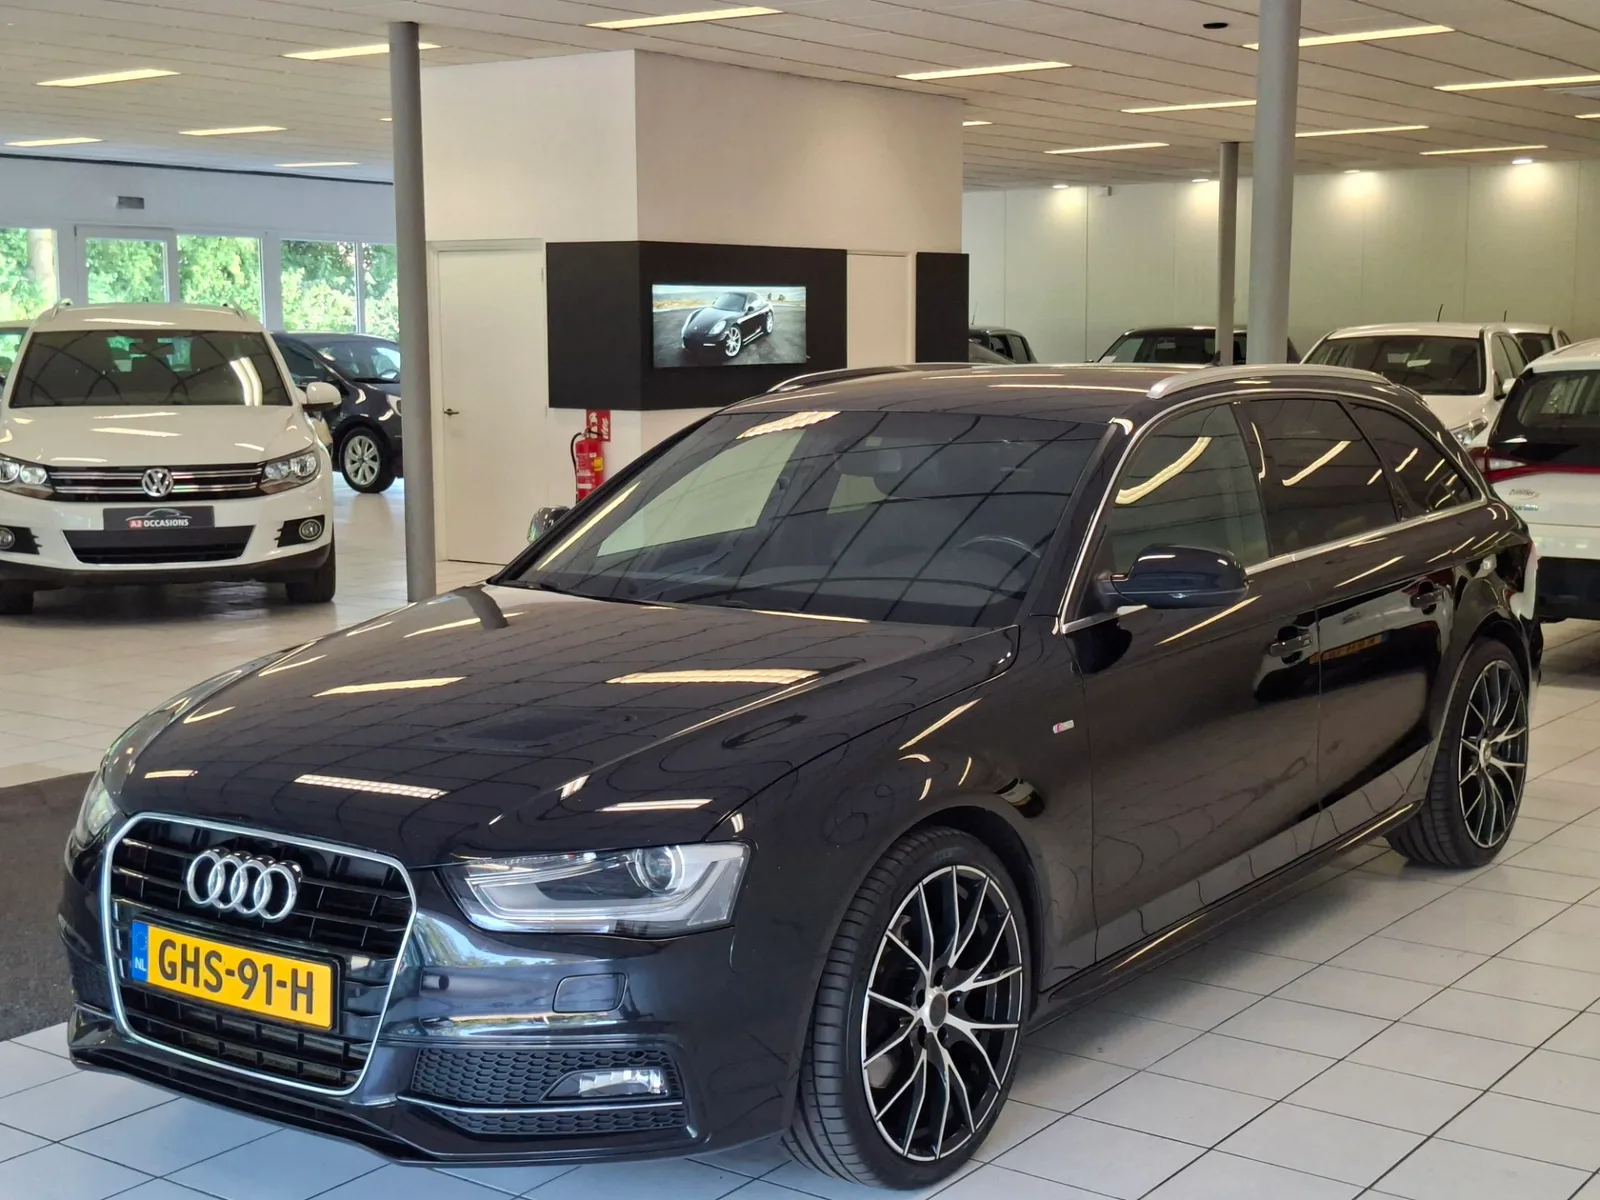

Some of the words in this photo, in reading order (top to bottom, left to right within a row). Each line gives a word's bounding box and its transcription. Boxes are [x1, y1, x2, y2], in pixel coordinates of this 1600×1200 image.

[130, 520, 142, 528] A2
[143, 519, 189, 528] OCCASIONS
[134, 956, 147, 972] NL
[158, 938, 314, 1015] GHS-91-H
